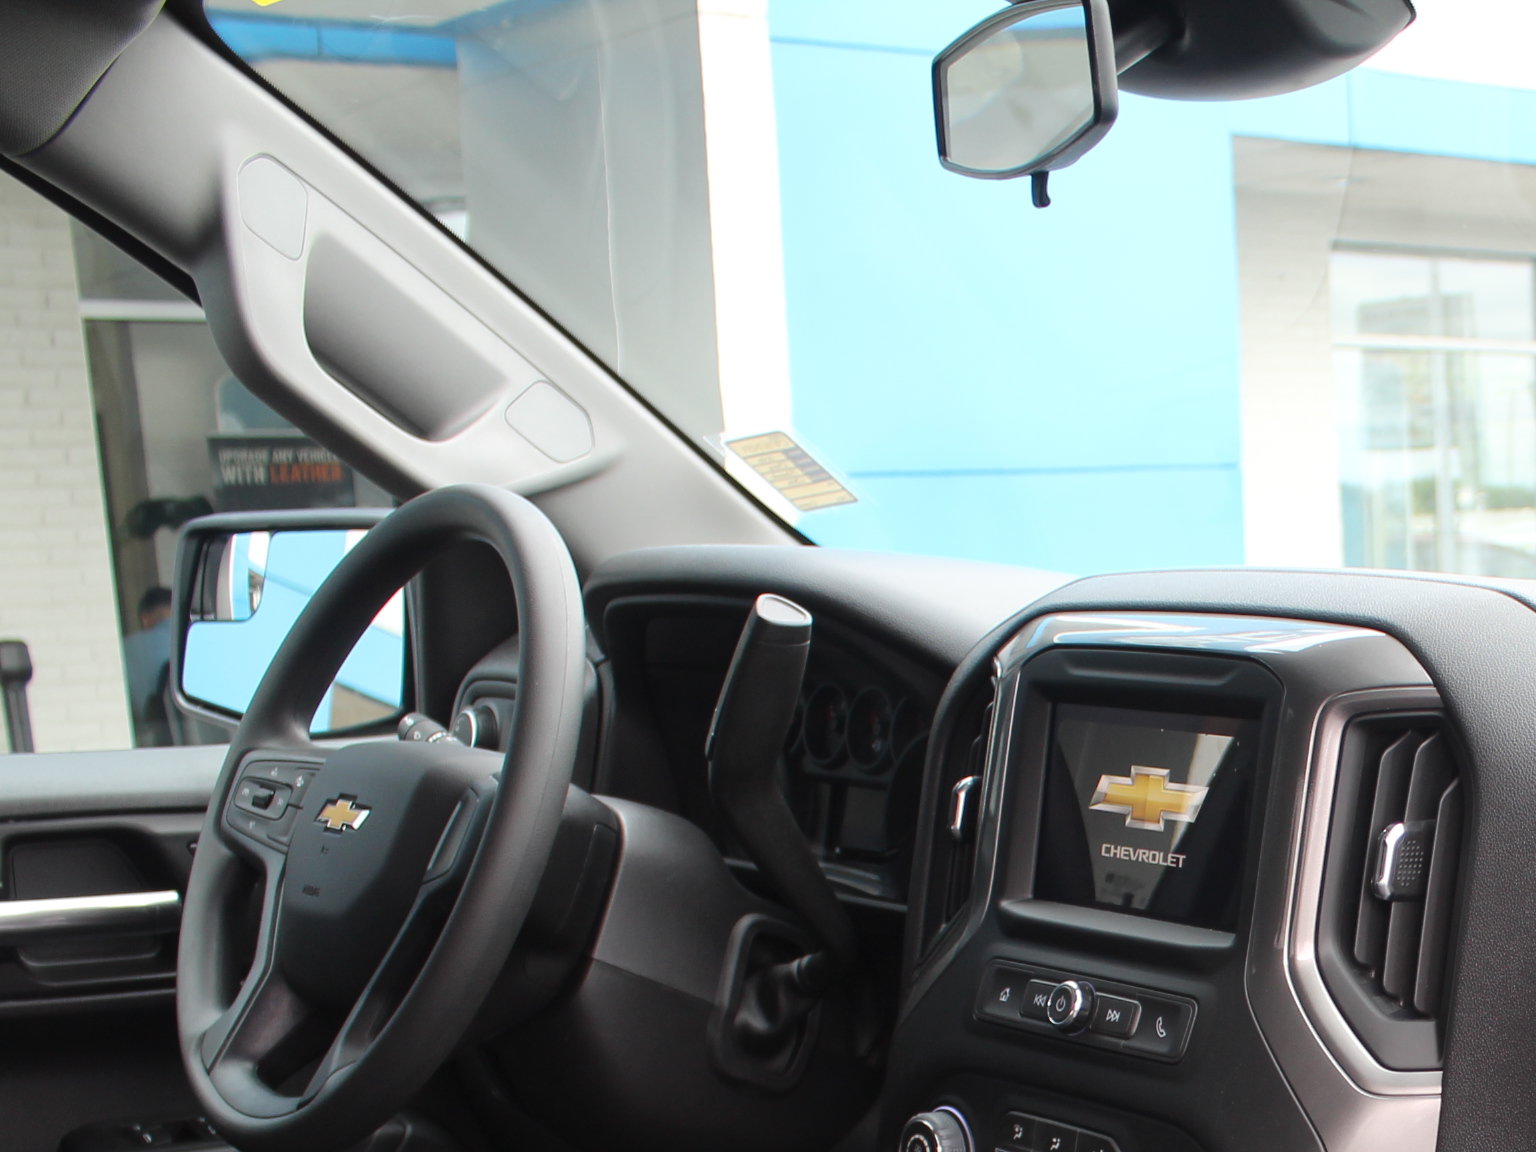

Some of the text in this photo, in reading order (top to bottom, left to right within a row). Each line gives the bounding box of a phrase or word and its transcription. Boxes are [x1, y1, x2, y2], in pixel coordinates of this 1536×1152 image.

[272, 448, 292, 463] ANY
[222, 463, 342, 485] WITH LEATHER
[1101, 843, 1186, 868] CHEVROLET
